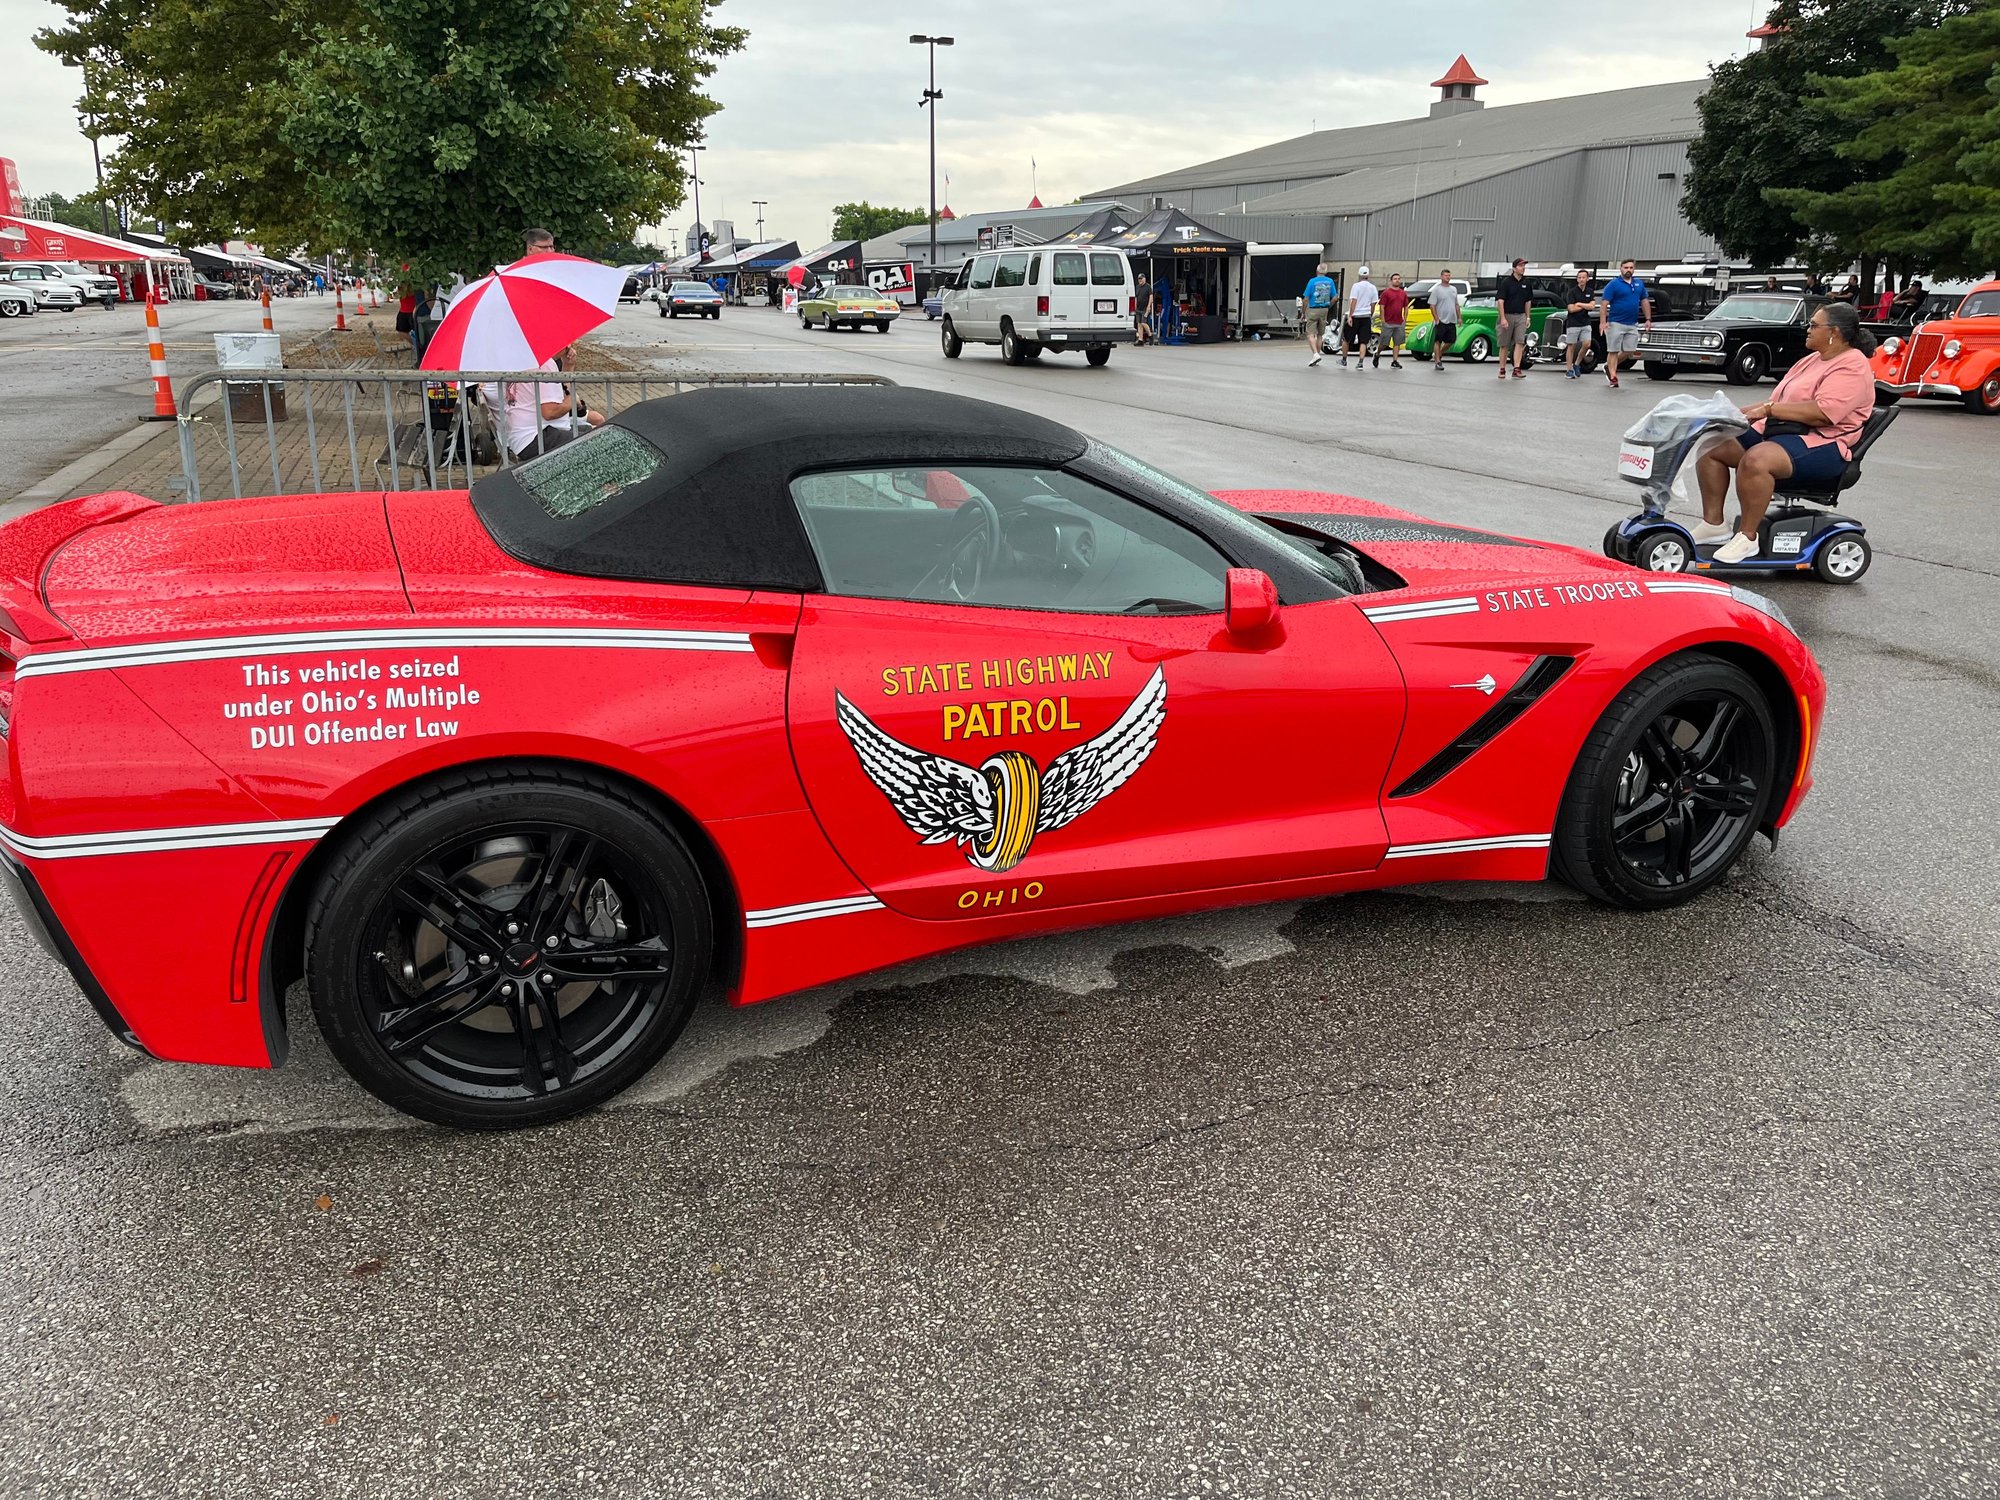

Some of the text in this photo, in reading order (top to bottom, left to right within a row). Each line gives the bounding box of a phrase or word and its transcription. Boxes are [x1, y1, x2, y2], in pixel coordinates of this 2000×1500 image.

[827, 258, 854, 272] QA1
[868, 263, 913, 290] QA1
[1485, 581, 1644, 613] STATE TROOPER
[242, 655, 460, 687] This vehicle seized
[882, 651, 1113, 696] STATE HIGHWAY
[224, 684, 480, 719] under Ohio's Multiple
[251, 716, 459, 749] DUI Offender Law
[943, 696, 1081, 741] PATROL
[957, 881, 1044, 909] OHIO
